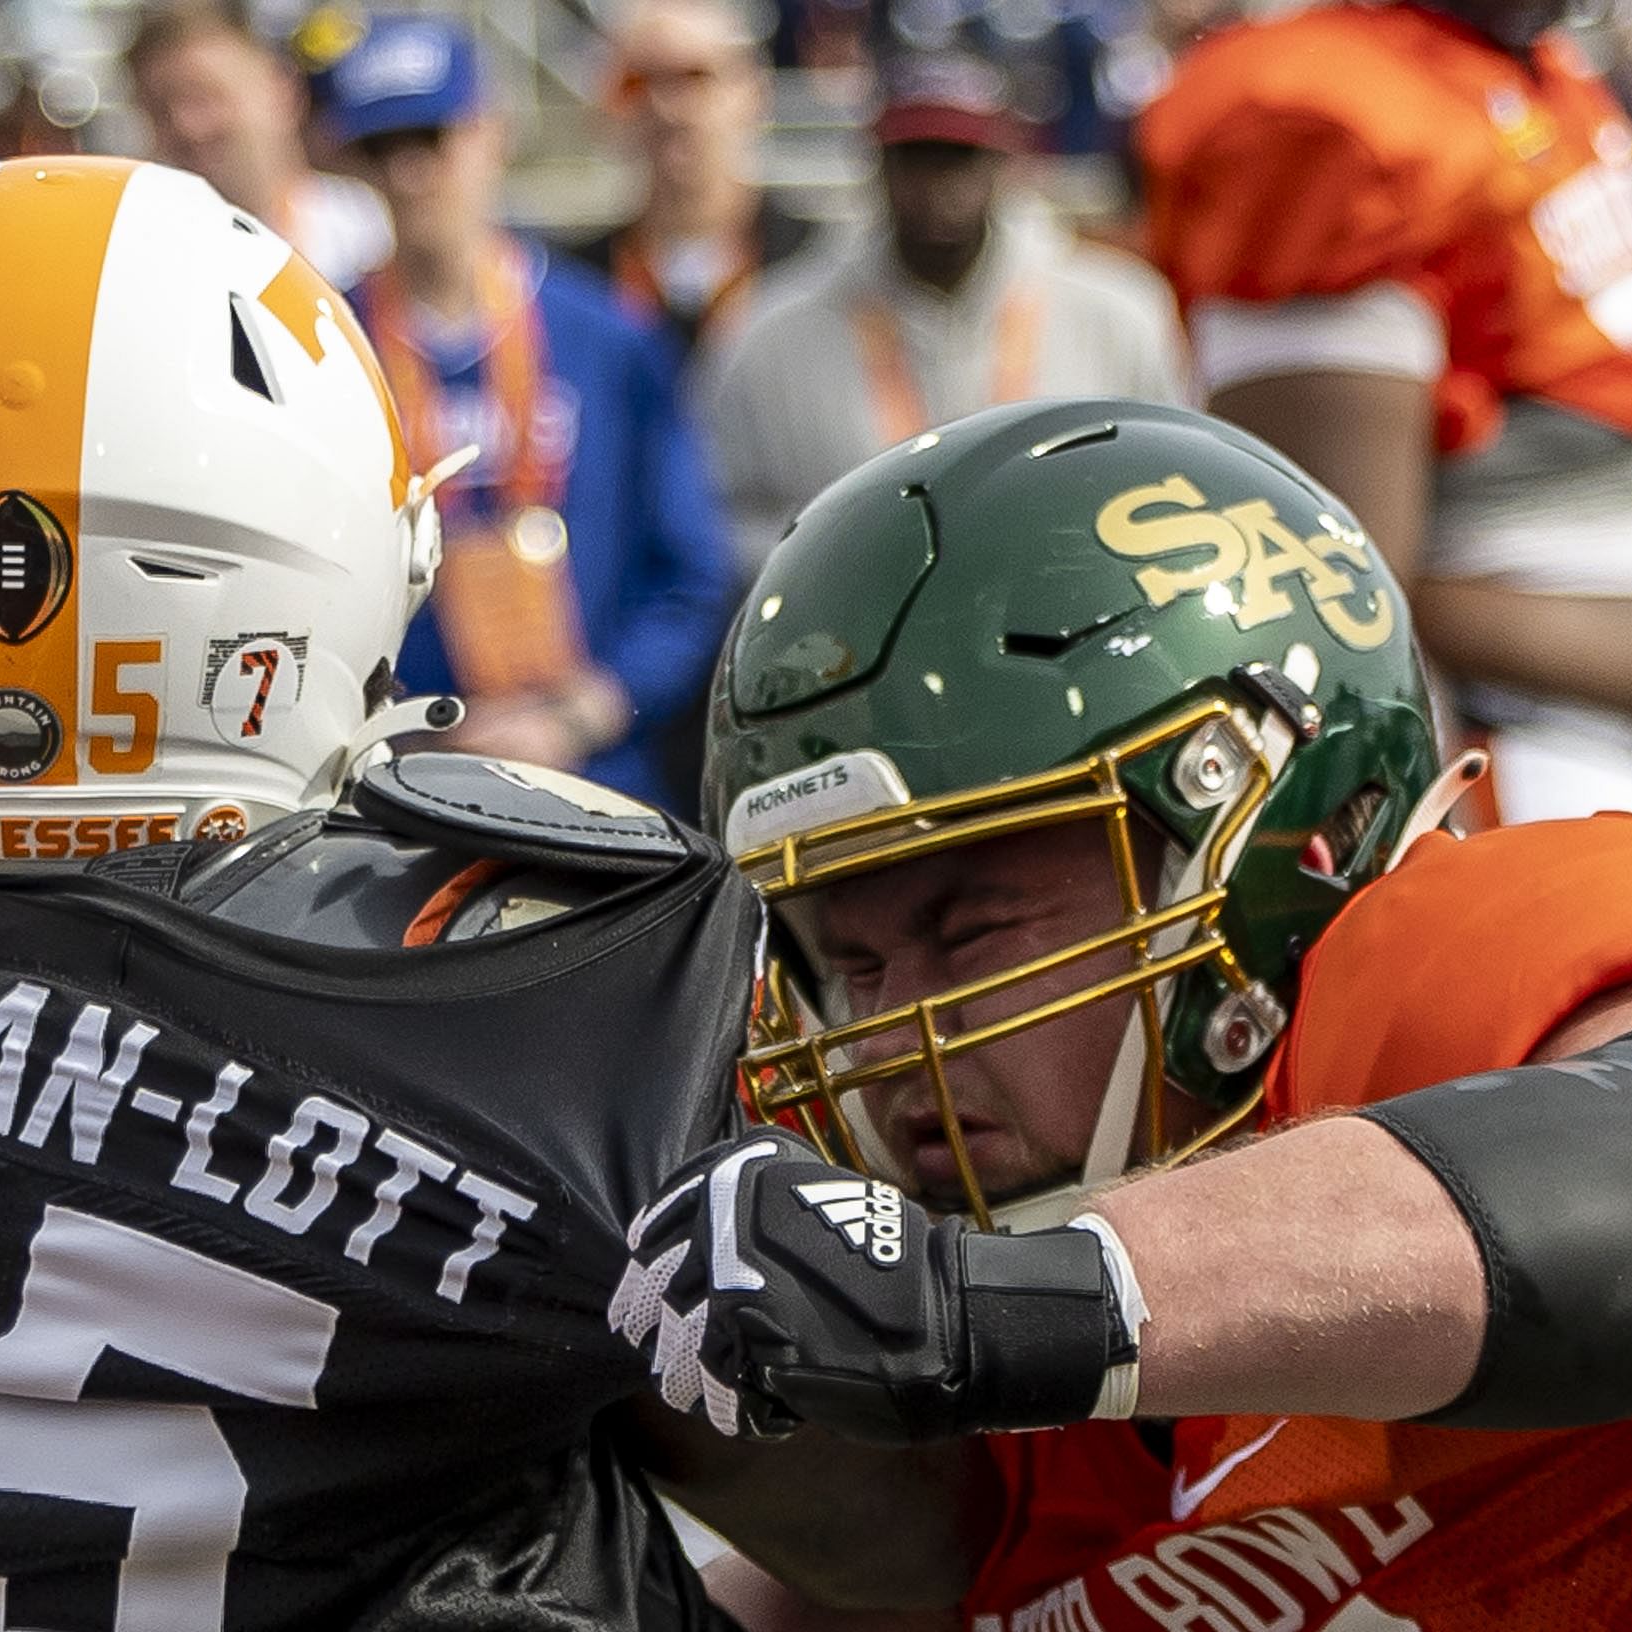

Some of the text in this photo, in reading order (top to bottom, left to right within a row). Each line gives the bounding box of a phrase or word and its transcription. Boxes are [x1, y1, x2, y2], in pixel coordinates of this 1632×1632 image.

[1096, 475, 1394, 649] SAC
[87, 640, 163, 776] 5
[239, 649, 279, 738] 7
[746, 764, 849, 819] HORNETS
[864, 1179, 903, 1263] adidas
